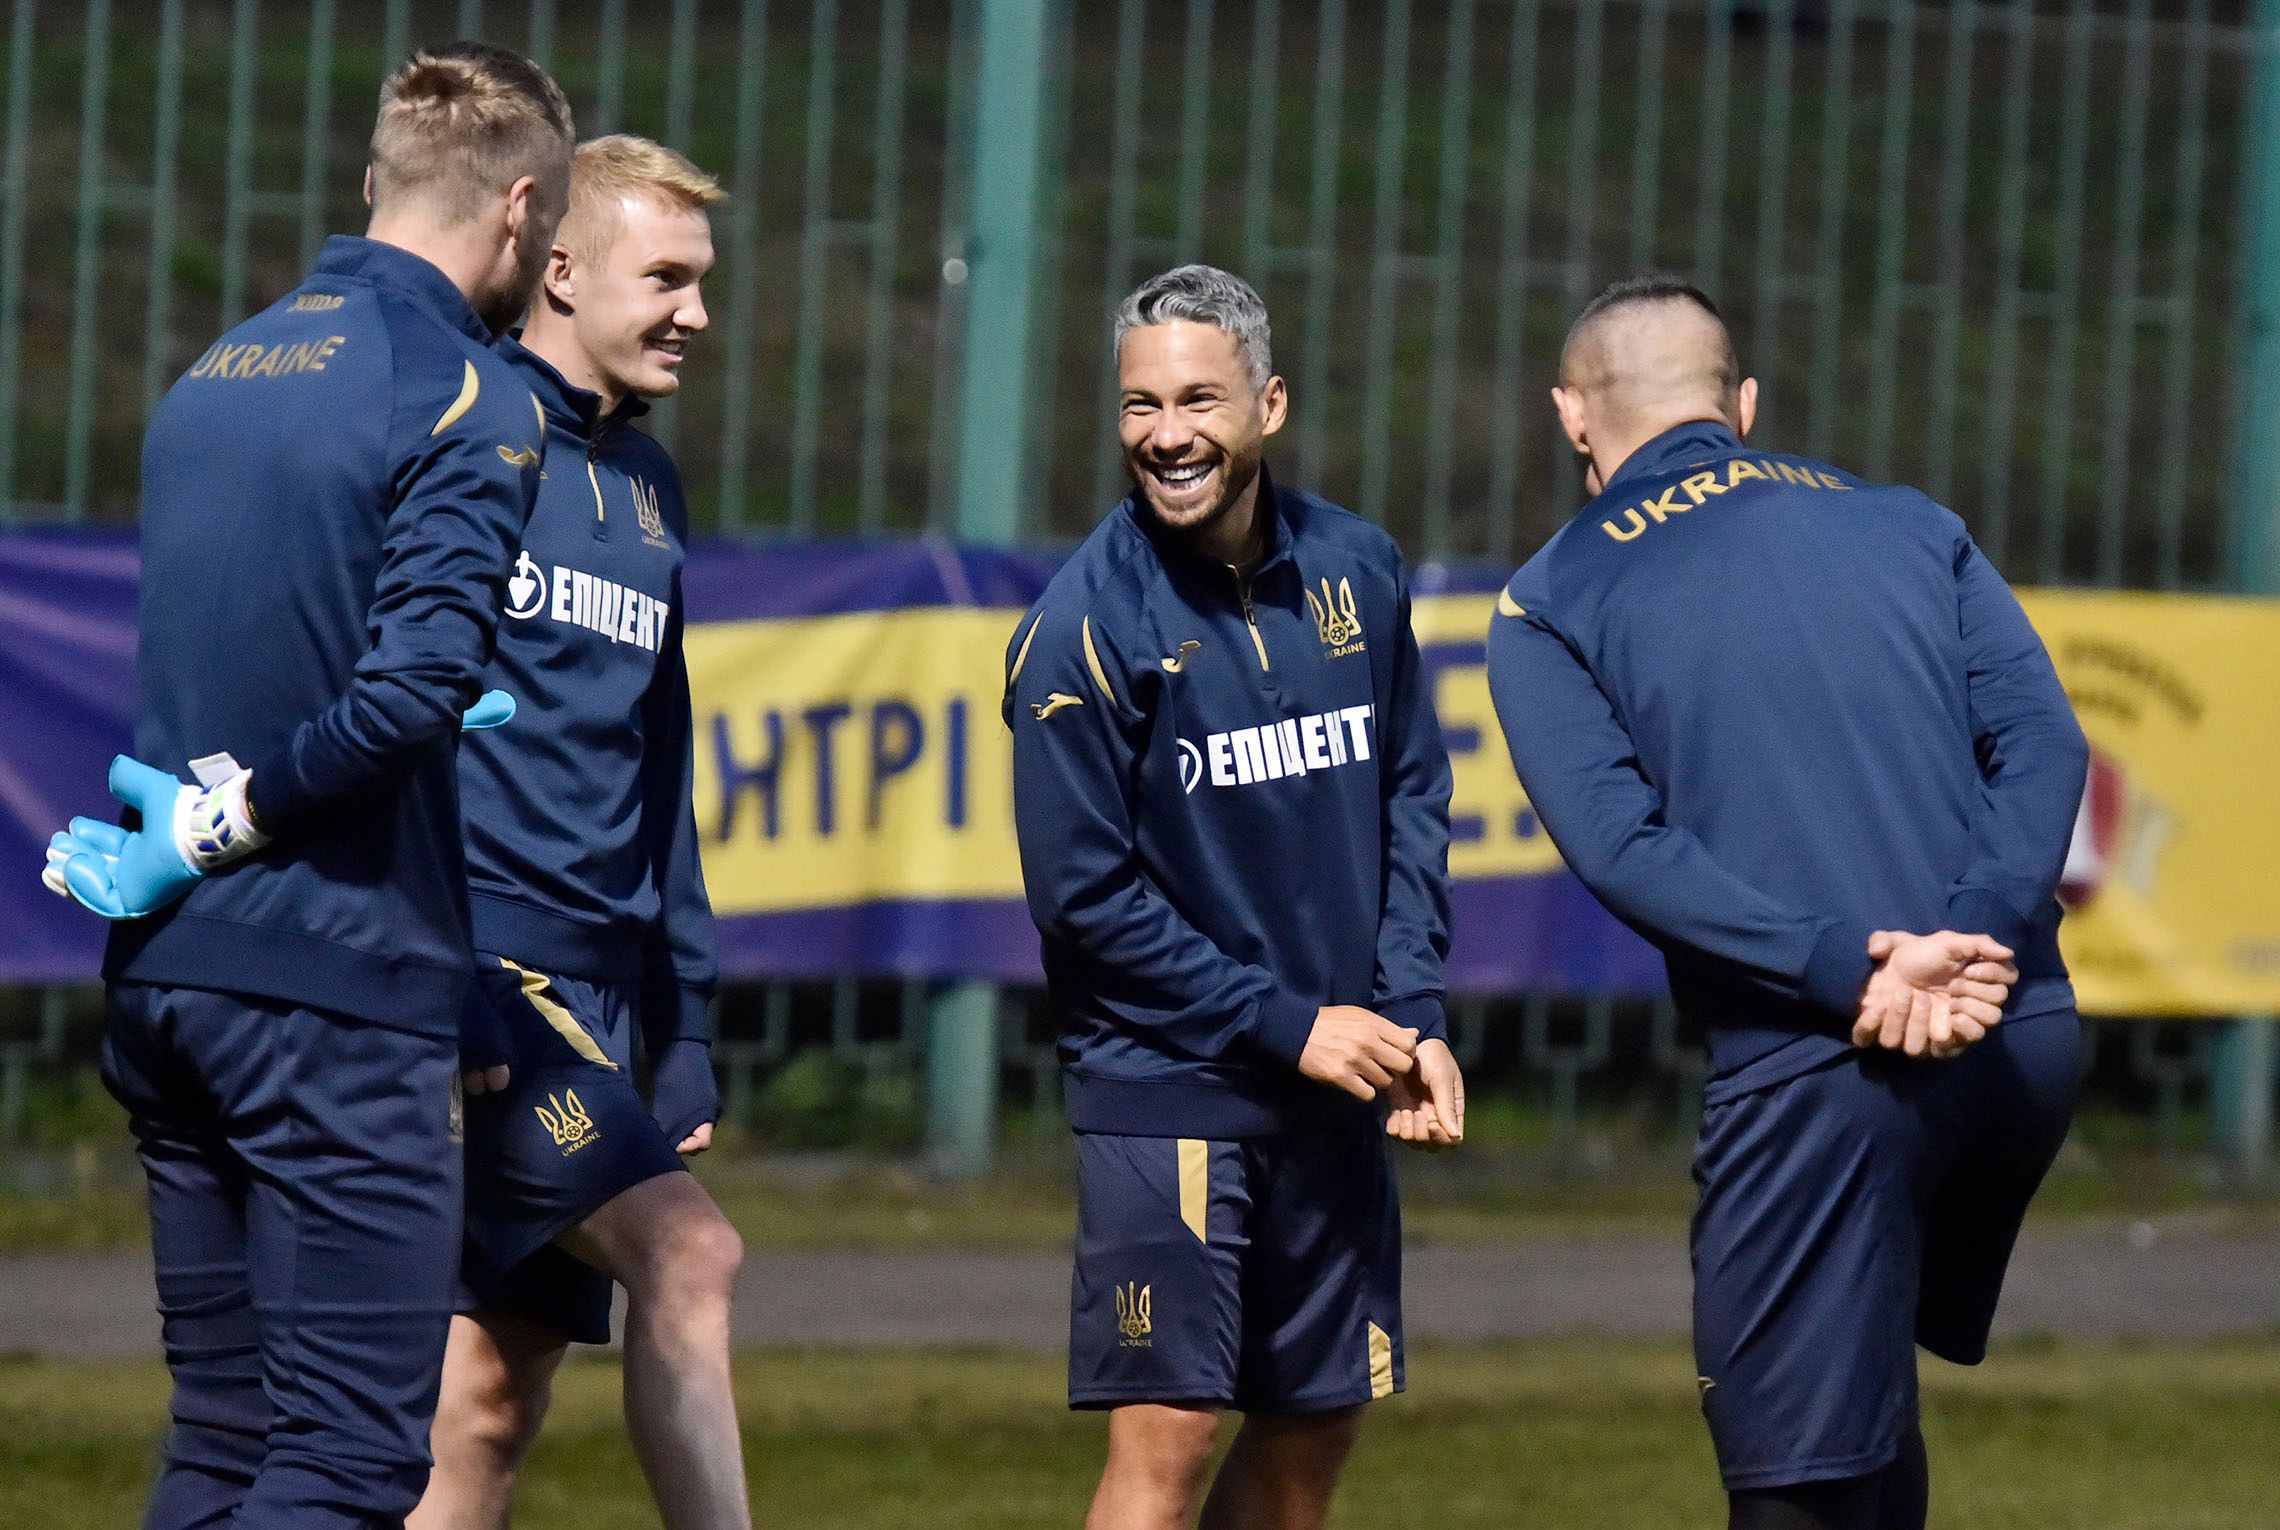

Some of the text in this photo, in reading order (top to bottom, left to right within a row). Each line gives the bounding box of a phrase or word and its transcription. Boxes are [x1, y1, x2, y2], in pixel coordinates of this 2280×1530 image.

[189, 335, 346, 379] UKRAINE
[1601, 459, 1855, 543] UKRAINE
[550, 565, 669, 655] ЕПІЦЕНТ
[1206, 704, 1371, 787] ЕПІЦЕНТ
[561, 1130, 602, 1157] UKRAINE
